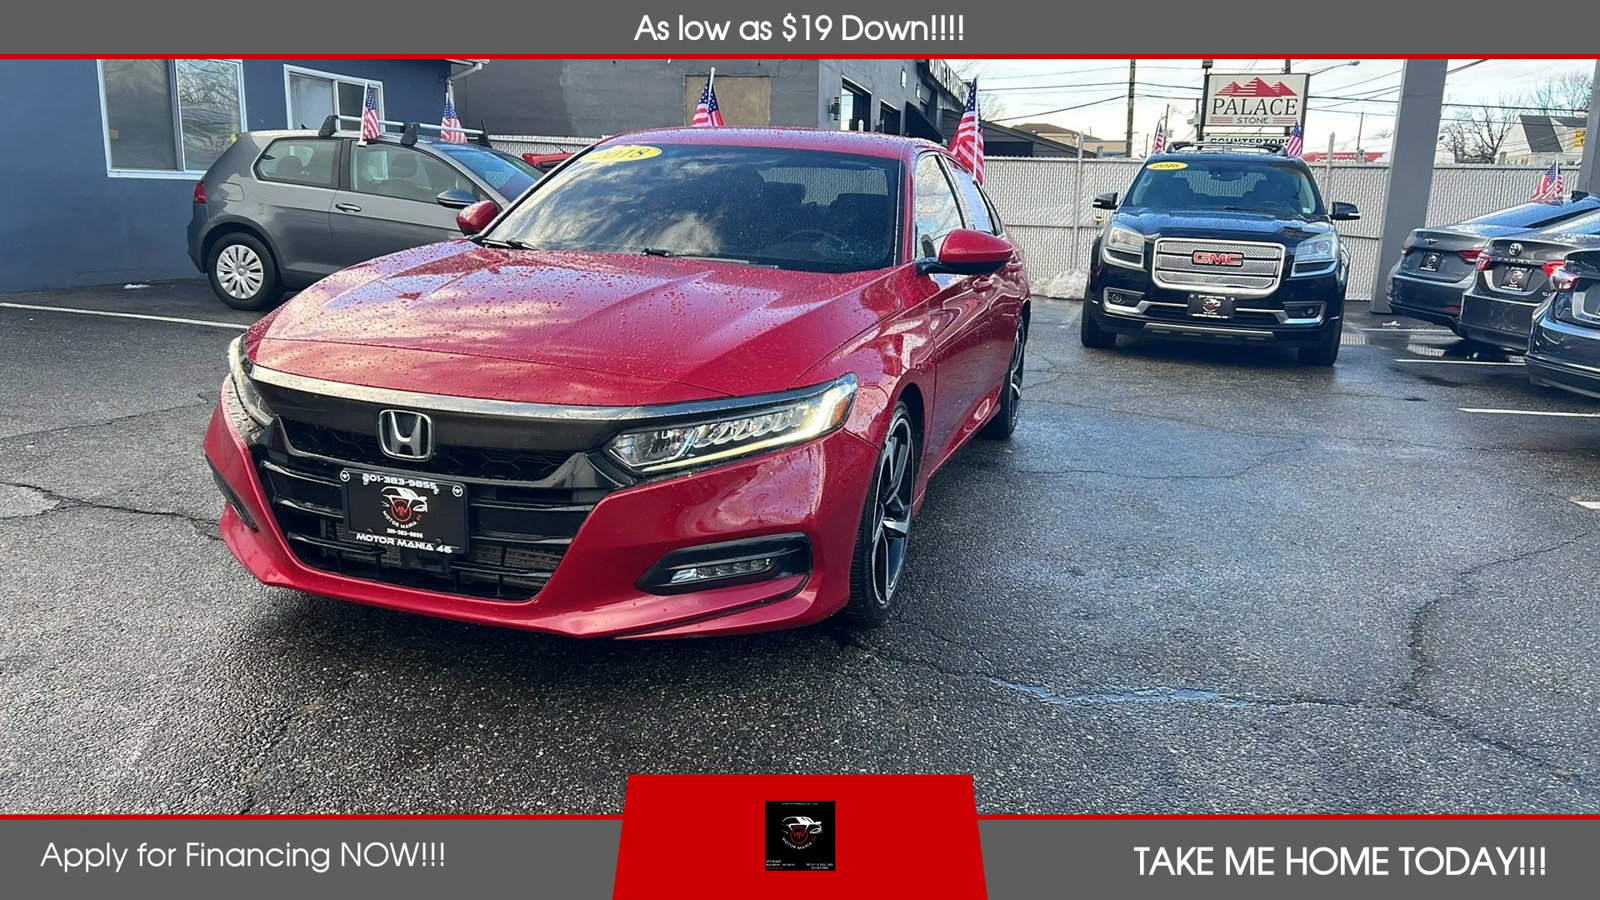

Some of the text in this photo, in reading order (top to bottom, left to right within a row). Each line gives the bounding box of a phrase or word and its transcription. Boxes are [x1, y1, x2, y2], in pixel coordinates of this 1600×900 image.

[1212, 98, 1298, 115] PALACE
[1237, 116, 1269, 124] STONE
[1193, 251, 1243, 266] GMC
[382, 510, 400, 527] MOTOR
[400, 520, 417, 529] MANIA
[356, 532, 453, 554] MOTOR MANIA 46
